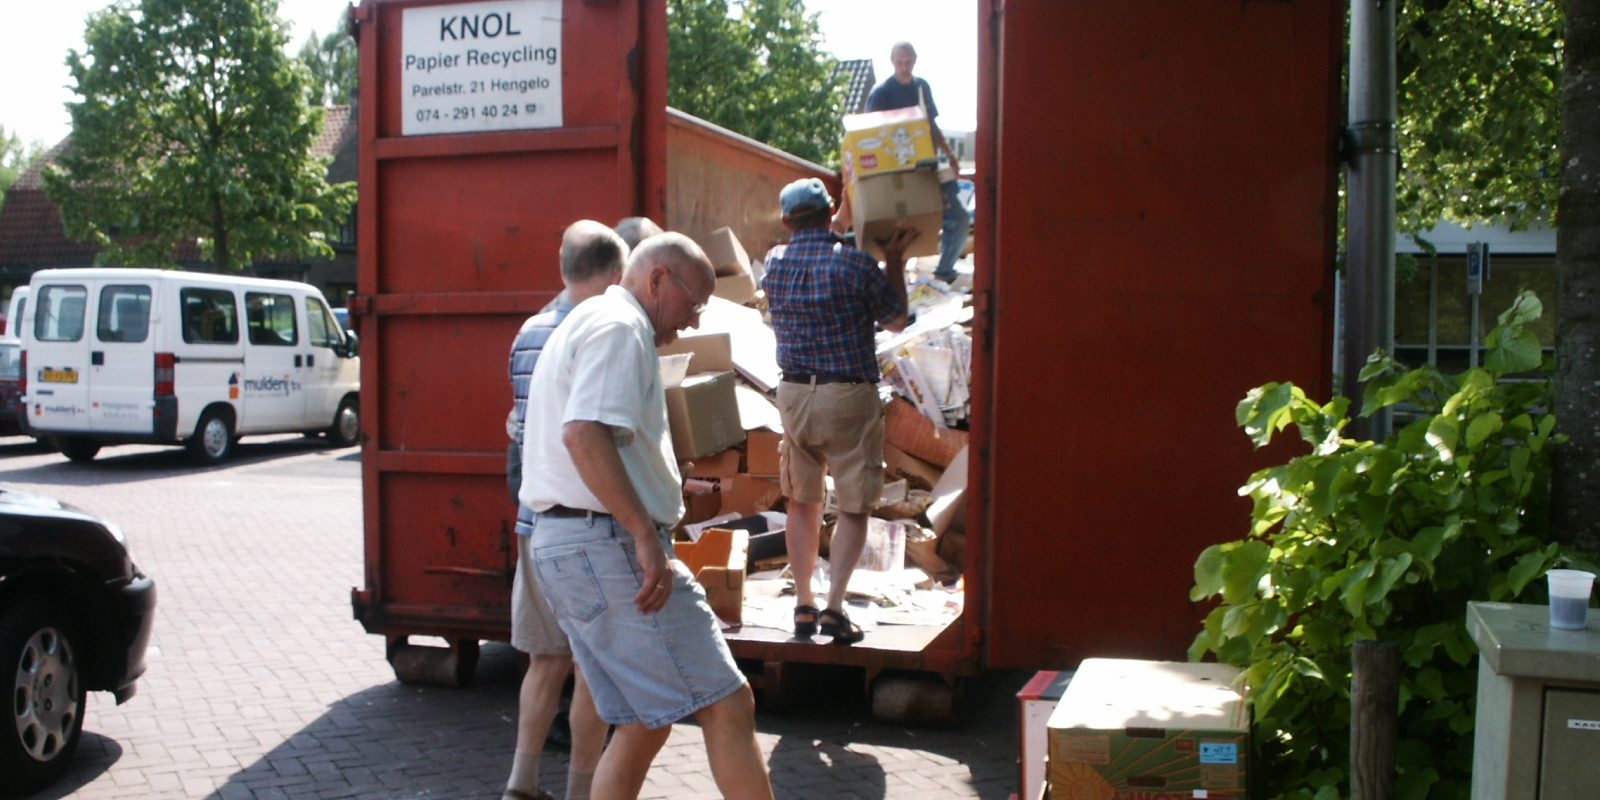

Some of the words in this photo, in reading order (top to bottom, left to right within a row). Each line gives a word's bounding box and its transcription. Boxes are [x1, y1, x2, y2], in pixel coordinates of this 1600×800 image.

[440, 12, 521, 41] KNOL
[405, 52, 460, 73] Papier
[466, 45, 557, 68] Recycling
[412, 83, 466, 97] Parelstr.
[470, 81, 485, 93] 21
[491, 77, 550, 94] Hengelo
[416, 109, 440, 122] 074
[453, 107, 476, 120] 291
[481, 105, 498, 118] 40
[502, 104, 518, 117] 24
